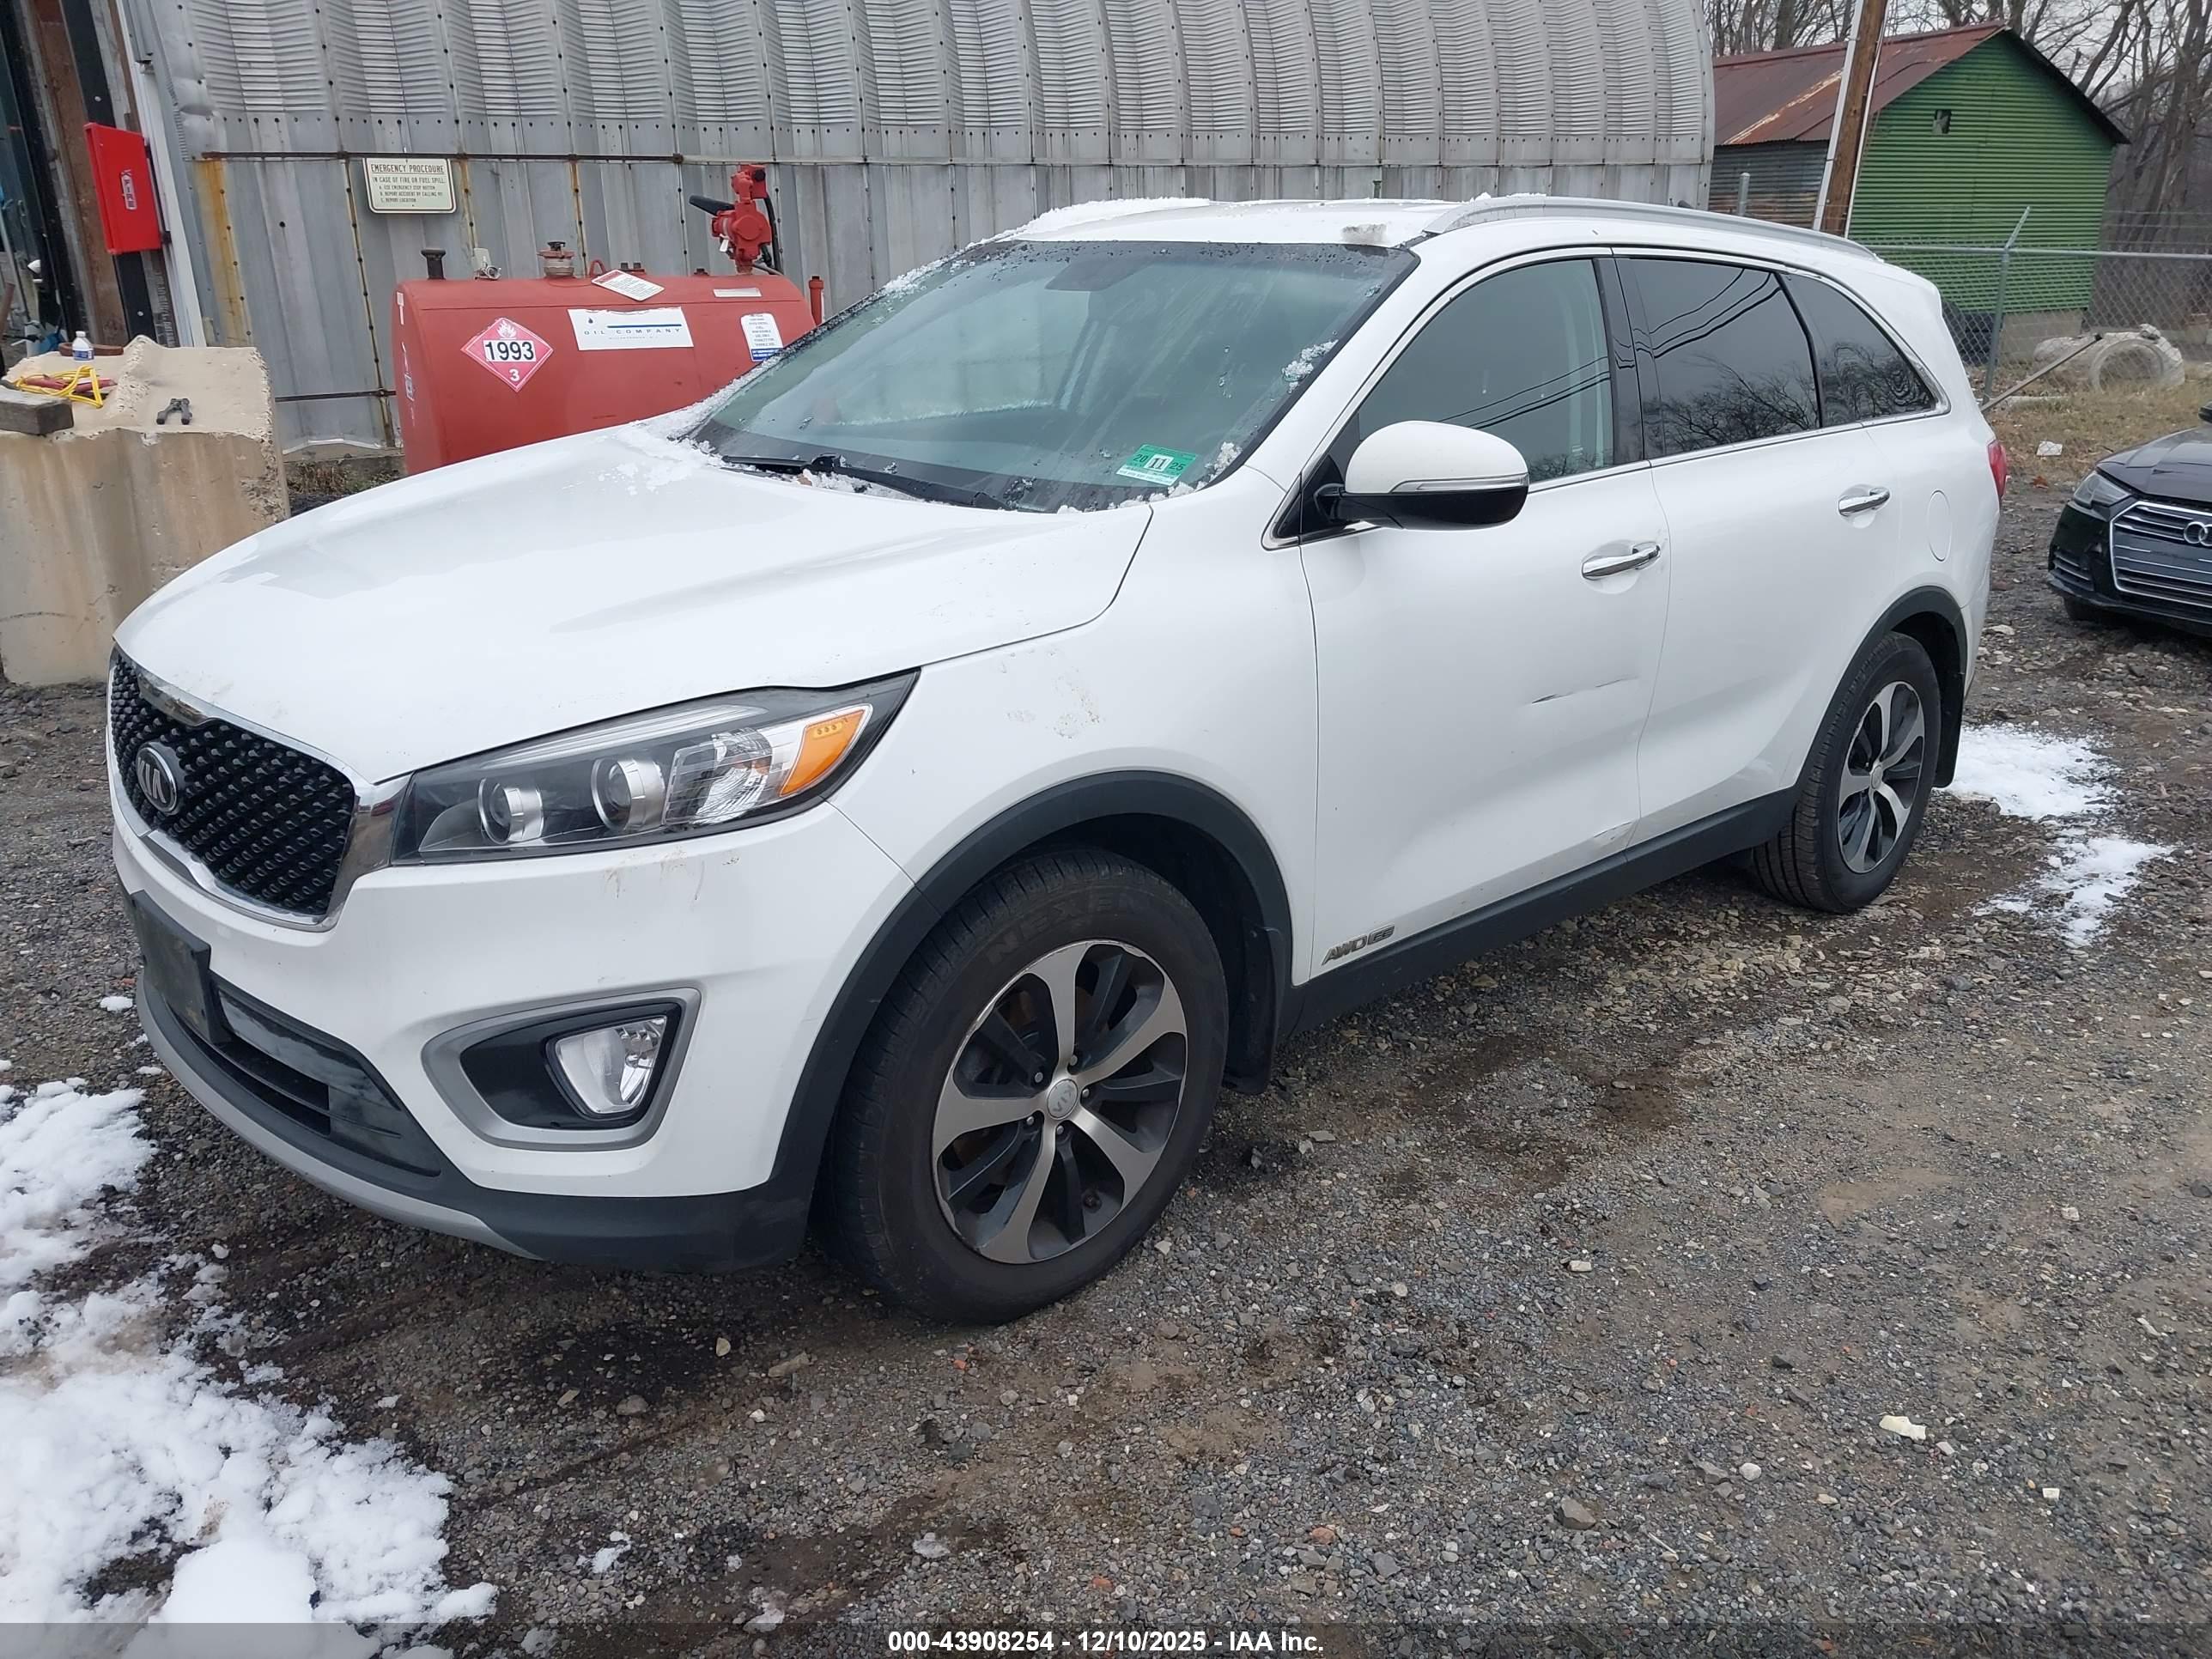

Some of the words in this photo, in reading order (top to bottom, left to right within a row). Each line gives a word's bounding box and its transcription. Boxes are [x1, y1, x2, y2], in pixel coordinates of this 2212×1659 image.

[485, 342, 534, 361] 1993
[508, 368, 520, 381] 3
[1133, 453, 1148, 463] 20
[1148, 457, 1167, 470] 11
[1169, 462, 1186, 471] 25
